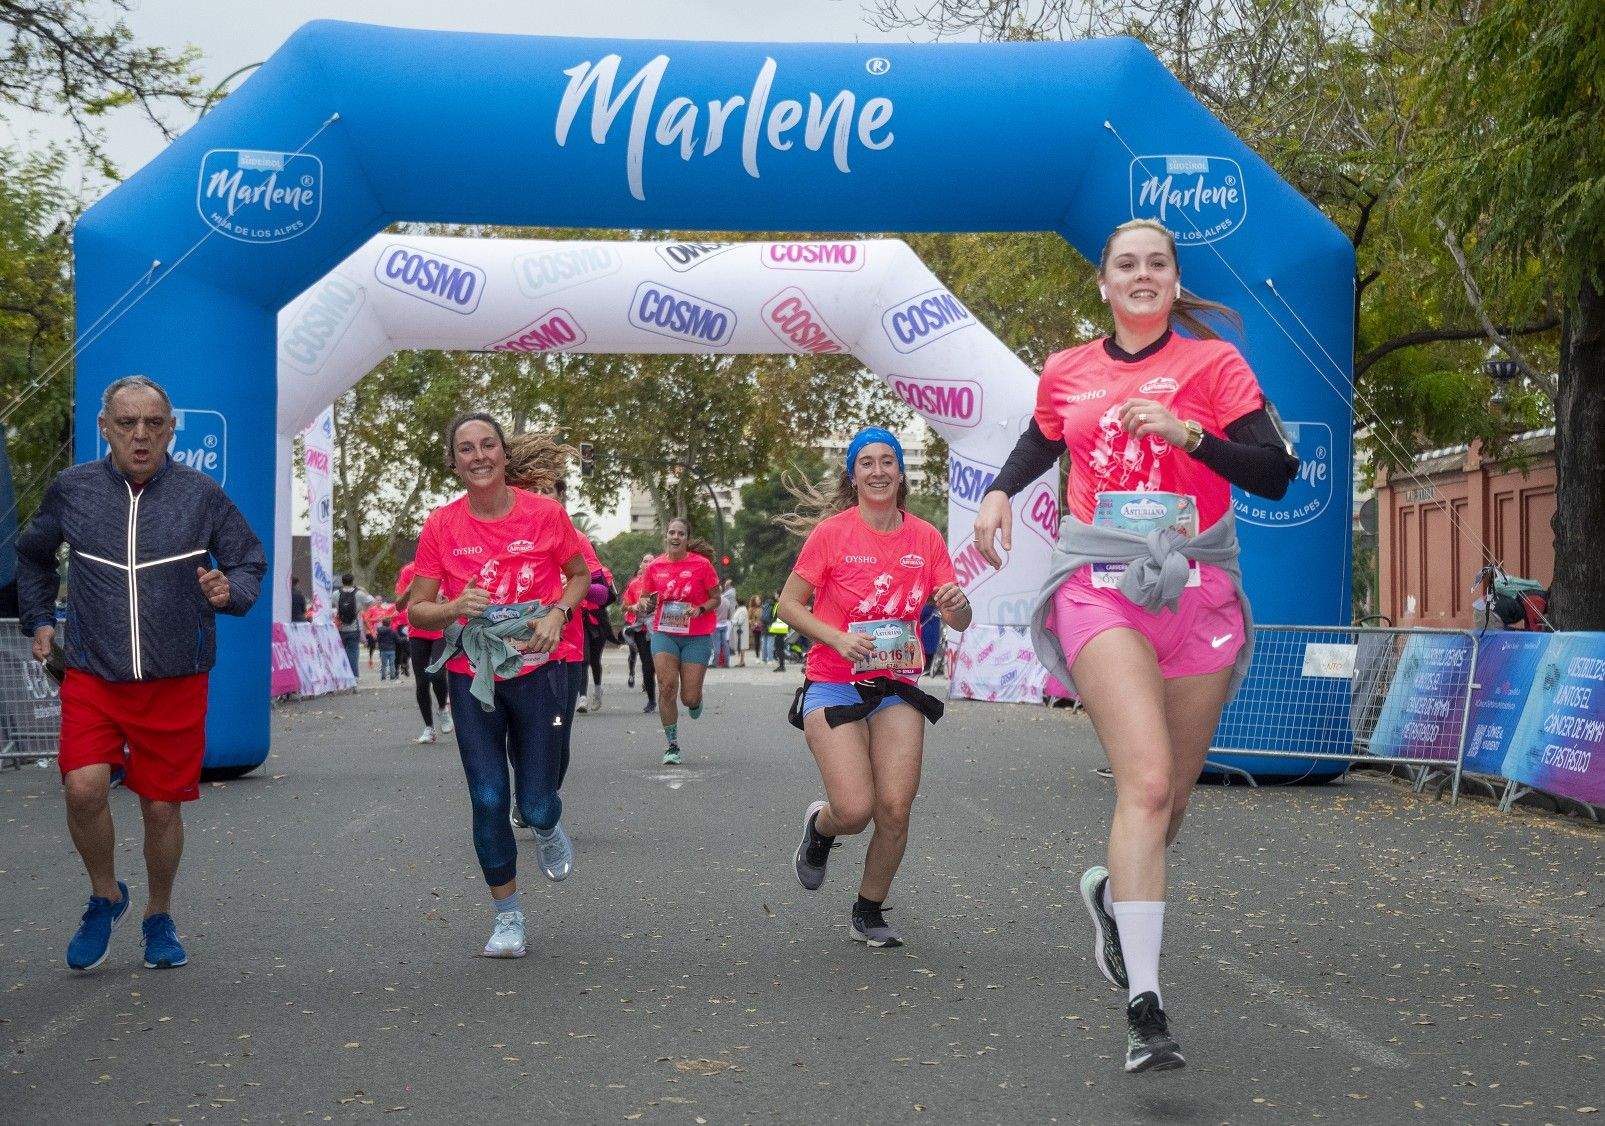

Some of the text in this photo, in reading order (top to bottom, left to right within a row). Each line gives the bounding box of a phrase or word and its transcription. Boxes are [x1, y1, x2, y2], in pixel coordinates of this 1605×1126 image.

[555, 54, 894, 201] Marlene
[206, 169, 313, 215] Marlene
[1139, 175, 1238, 221] Marlene
[235, 224, 248, 235] DE
[251, 229, 271, 238] LOS
[274, 220, 304, 236] ALPES
[1183, 232, 1201, 240] LOS
[1205, 218, 1232, 238] ALPES
[522, 246, 613, 290] COSMO
[770, 244, 857, 265] COSMO
[385, 249, 477, 306] COSMO
[639, 289, 728, 342] COSMO
[771, 296, 842, 354] COSM
[895, 380, 975, 420] COSMO
[1066, 388, 1107, 403] OYSHO
[1251, 508, 1267, 520] DE
[1269, 511, 1290, 520] LOS
[1293, 498, 1321, 519] ALPES
[453, 546, 483, 557] OYSHO
[845, 555, 877, 564] OYSHO
